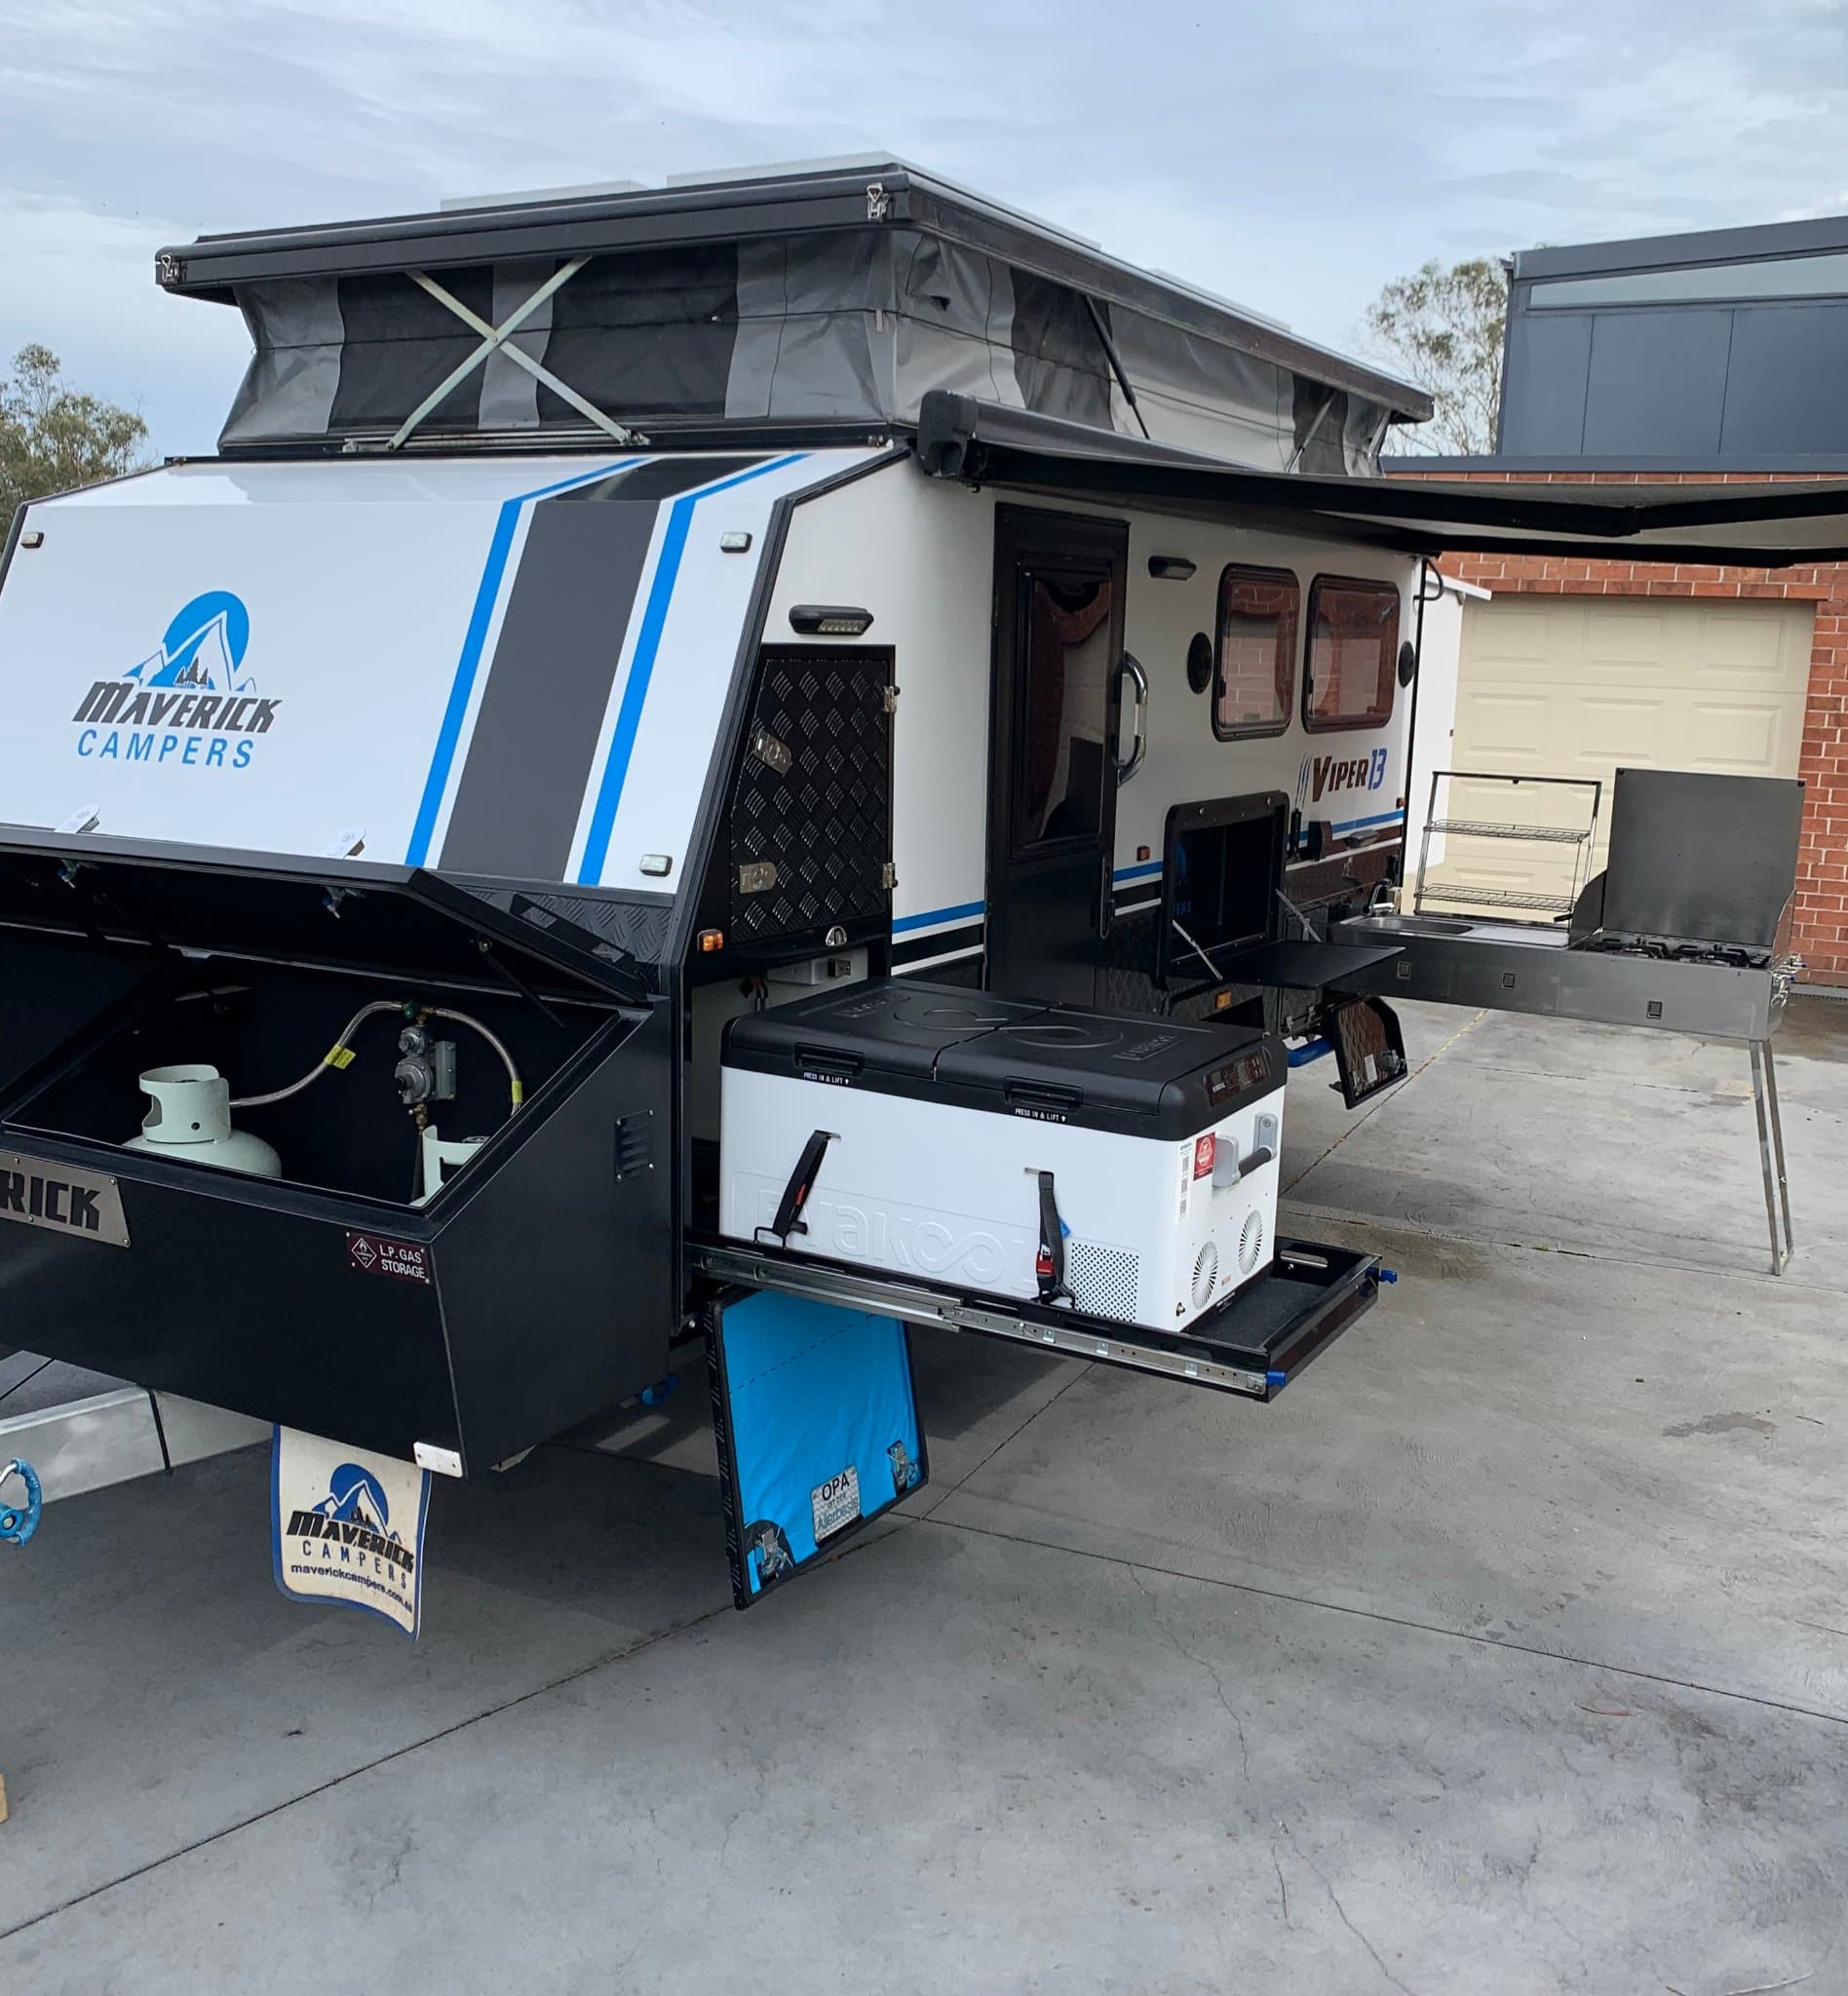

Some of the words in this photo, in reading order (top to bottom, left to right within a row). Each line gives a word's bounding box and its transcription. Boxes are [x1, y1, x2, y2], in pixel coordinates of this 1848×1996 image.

[72, 681, 284, 733] MAVERICK
[77, 729, 254, 768] CAMPERS
[1312, 755, 1369, 802] VIPER
[1367, 748, 1388, 790] 13
[1046, 1113, 1059, 1122] LIFT
[381, 1258, 426, 1279] STORAGE
[822, 1472, 850, 1501] OPA
[287, 1511, 414, 1574] MAVERICK
[303, 1540, 406, 1590] CAMPERS
